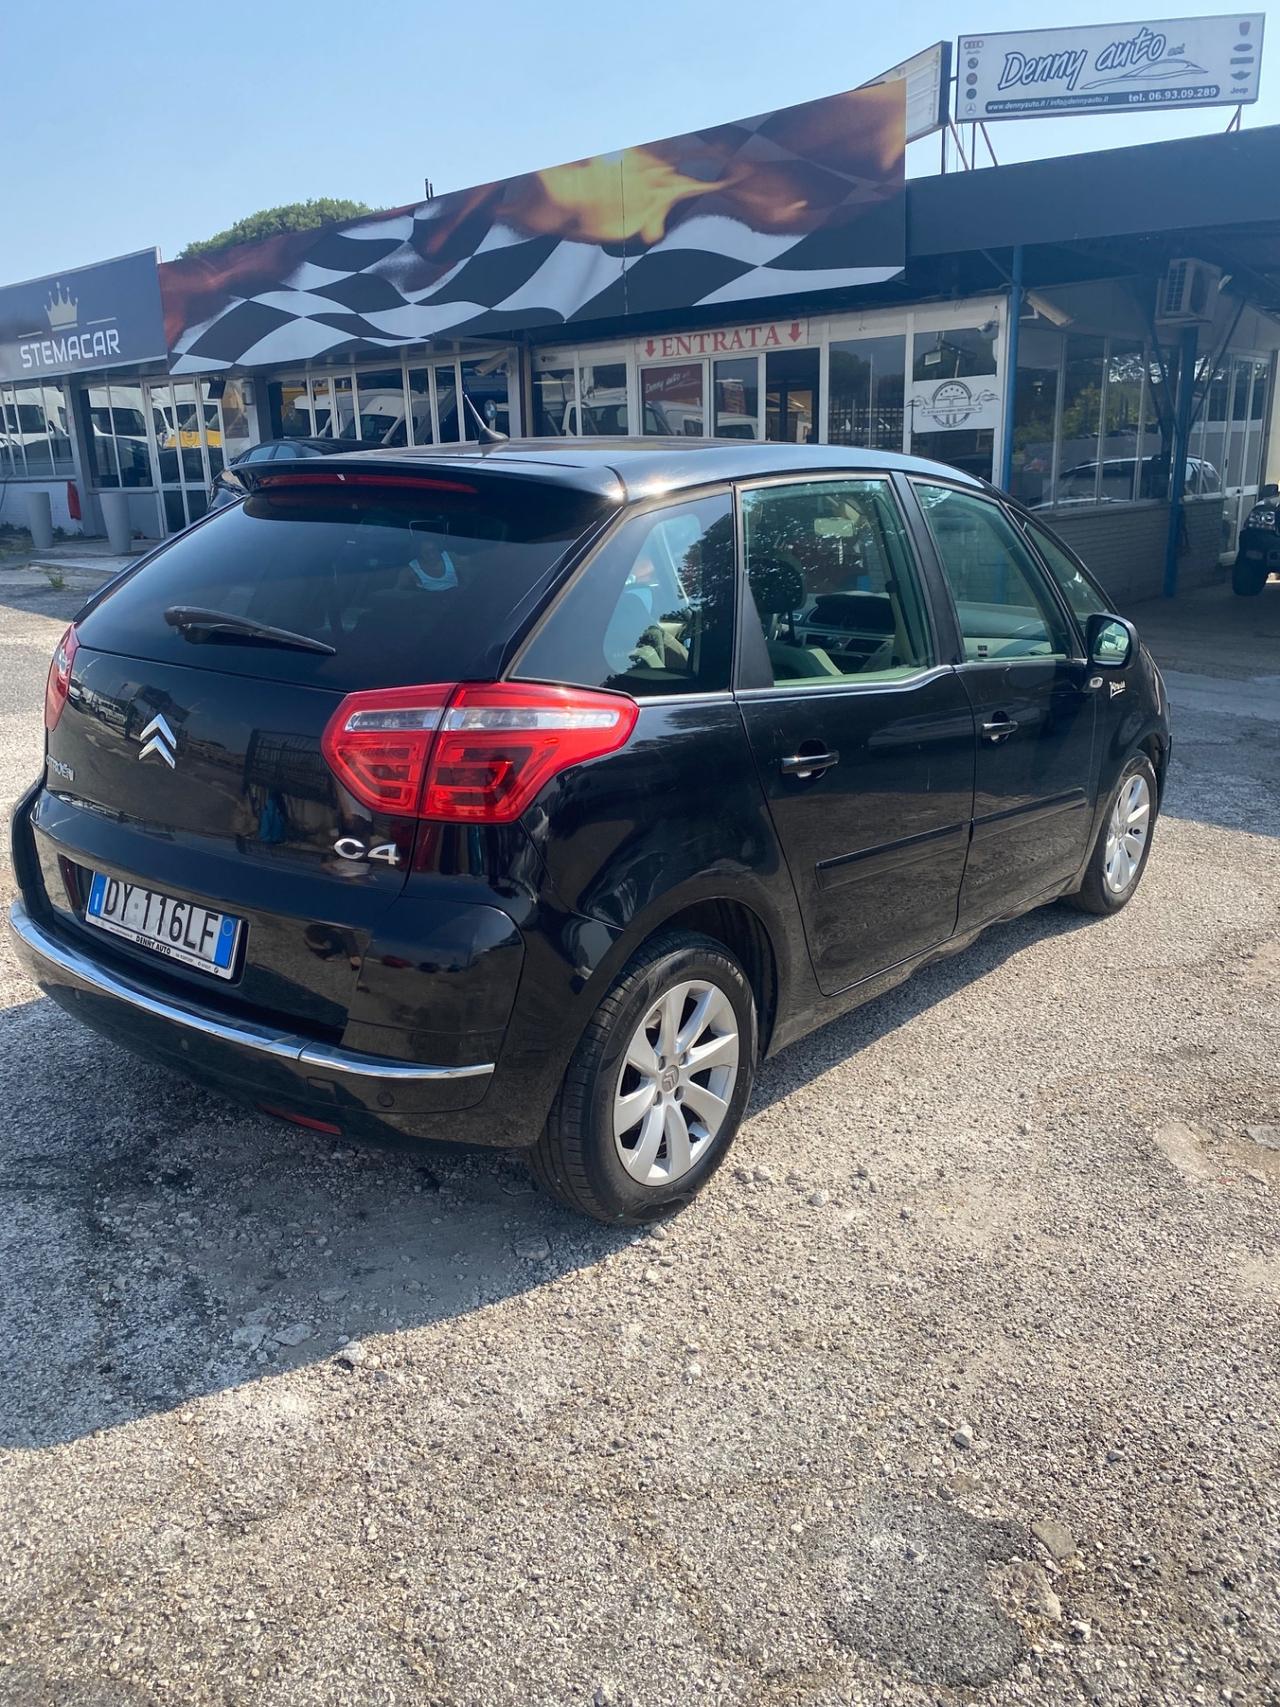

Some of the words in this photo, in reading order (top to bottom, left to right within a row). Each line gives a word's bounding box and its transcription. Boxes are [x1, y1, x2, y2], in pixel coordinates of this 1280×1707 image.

[998, 49, 1088, 91] Denny
[1095, 27, 1166, 71] auto
[1128, 93, 1145, 102] tel.
[1149, 87, 1217, 101] 06.93.09.289
[20, 329, 121, 369] STEMACAR
[660, 325, 782, 357] ENTRATA
[334, 838, 400, 865] C4
[136, 935, 155, 949] DENNY
[156, 943, 171, 955] AUTO
